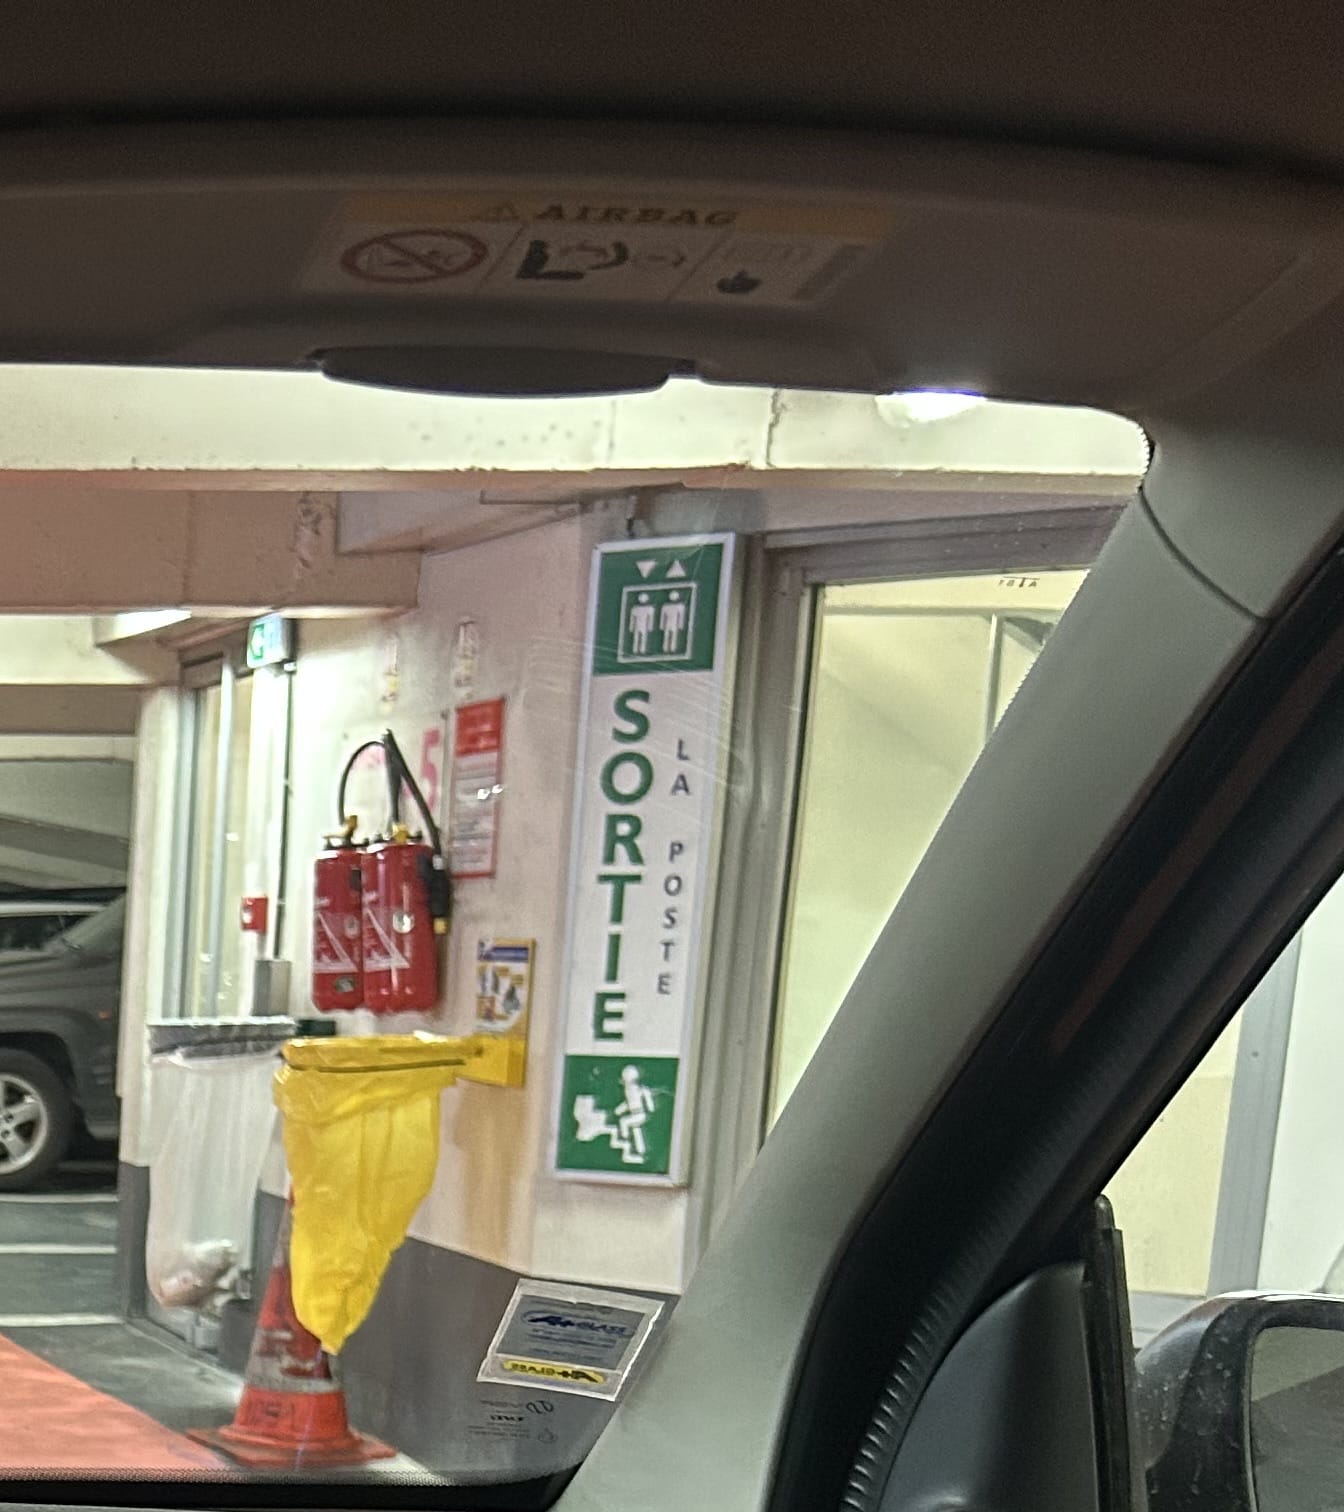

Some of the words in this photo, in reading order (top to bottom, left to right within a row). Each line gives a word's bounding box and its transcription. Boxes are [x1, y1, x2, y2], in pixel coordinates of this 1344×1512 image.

[534, 205, 737, 226] AIRBAG
[670, 739, 691, 796] LA
[593, 689, 654, 1041] SORTIE
[657, 840, 685, 995] POSTE
